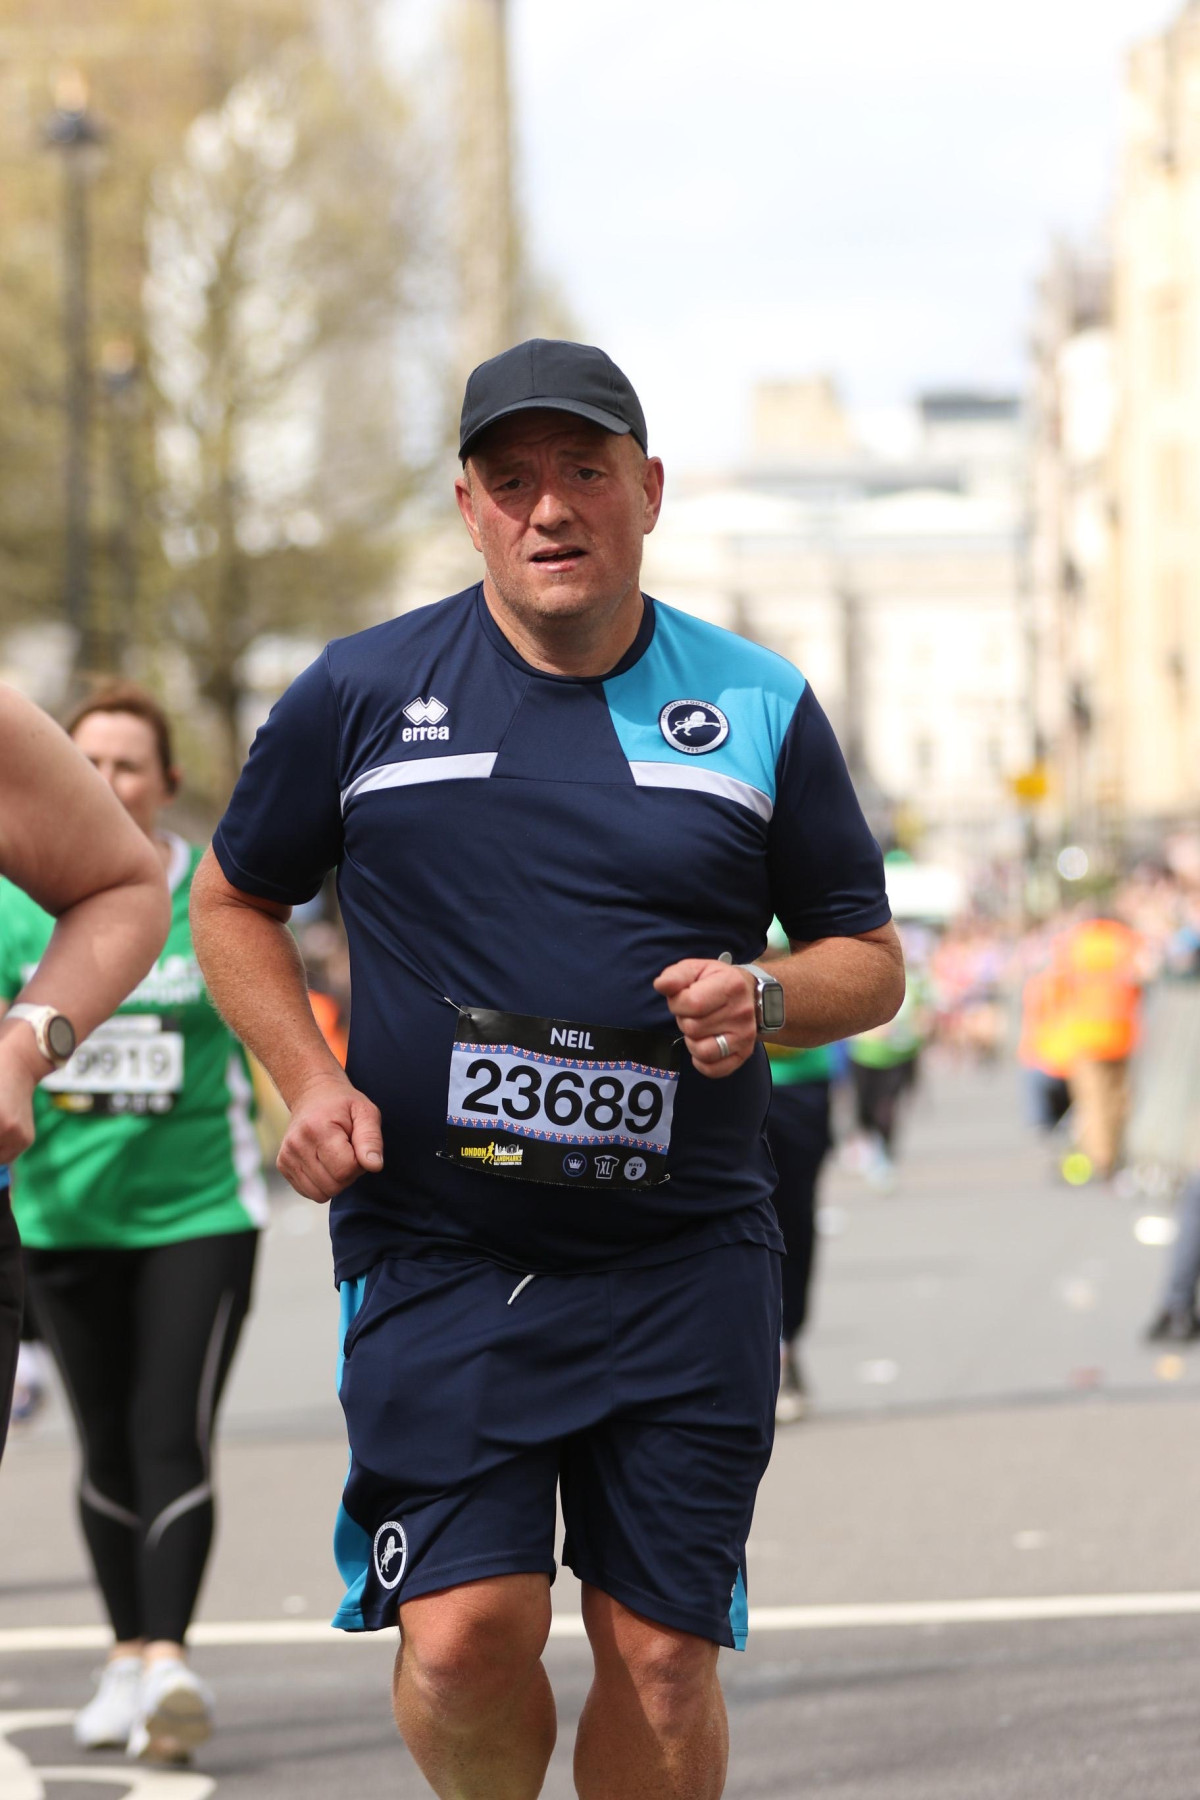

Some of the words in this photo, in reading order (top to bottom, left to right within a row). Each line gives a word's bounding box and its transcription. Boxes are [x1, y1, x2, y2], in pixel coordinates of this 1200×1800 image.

[662, 701, 684, 719] MILLWALL
[686, 701, 718, 713] FOOTBALL
[550, 1027, 595, 1050] NEIL
[461, 1058, 664, 1135] 23689
[461, 1147, 487, 1157] LONDON
[600, 1161, 610, 1175] XL
[630, 1168, 637, 1177] 8
